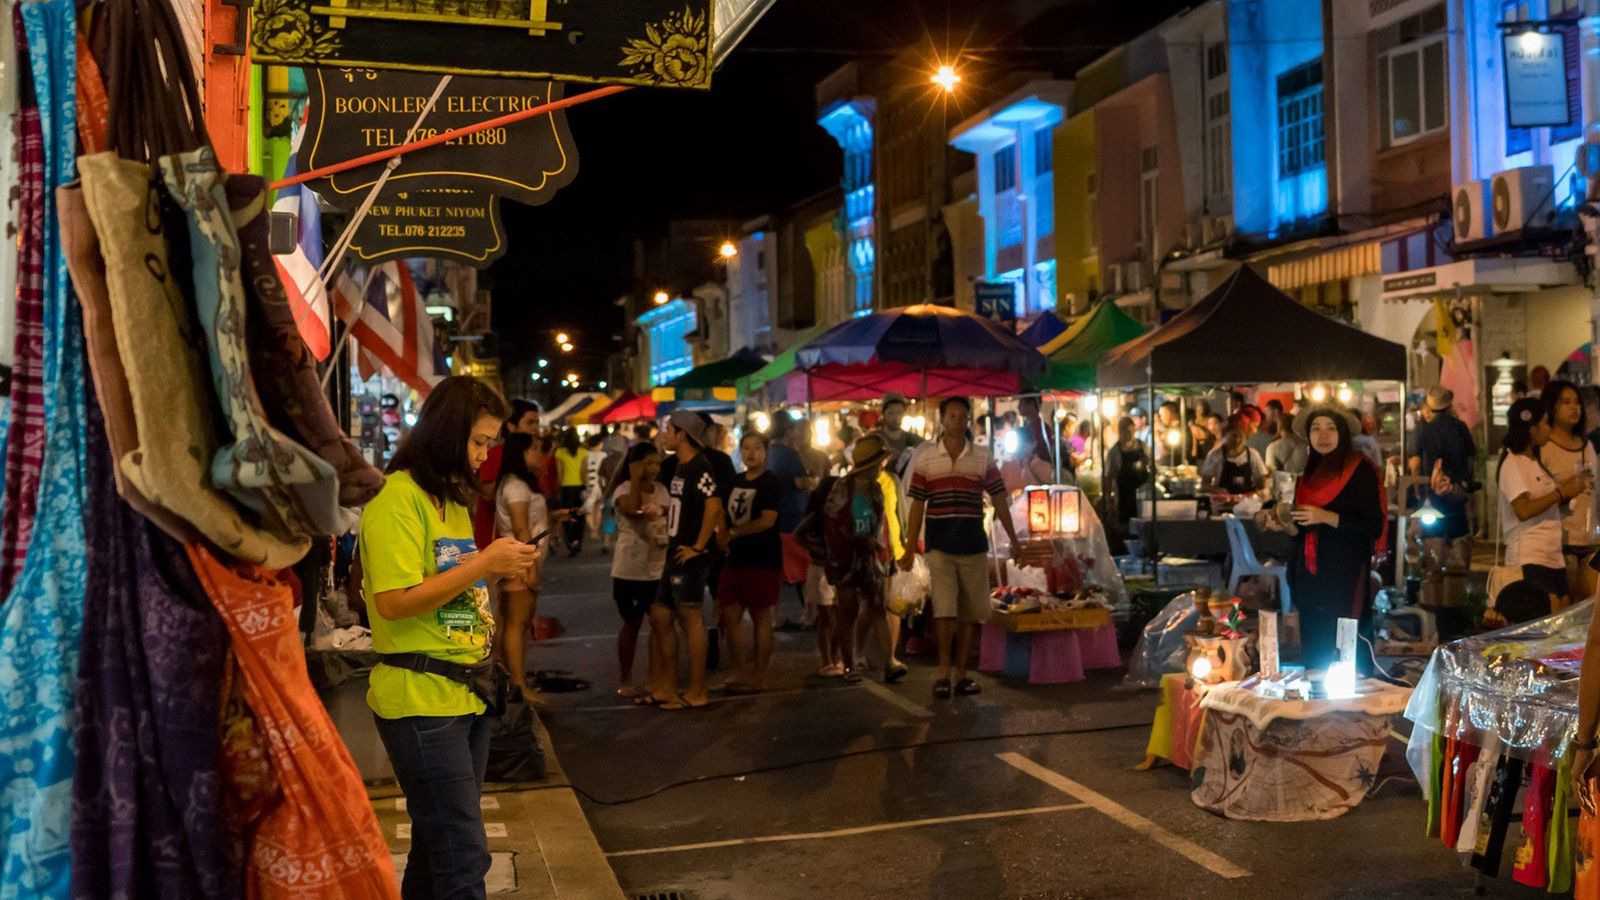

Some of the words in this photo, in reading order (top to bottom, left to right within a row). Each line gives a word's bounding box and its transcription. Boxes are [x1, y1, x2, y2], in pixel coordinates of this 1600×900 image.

[447, 95, 540, 114] ELECTRIC
[394, 205, 440, 218] PHUKET
[445, 206, 486, 219] NIYOM
